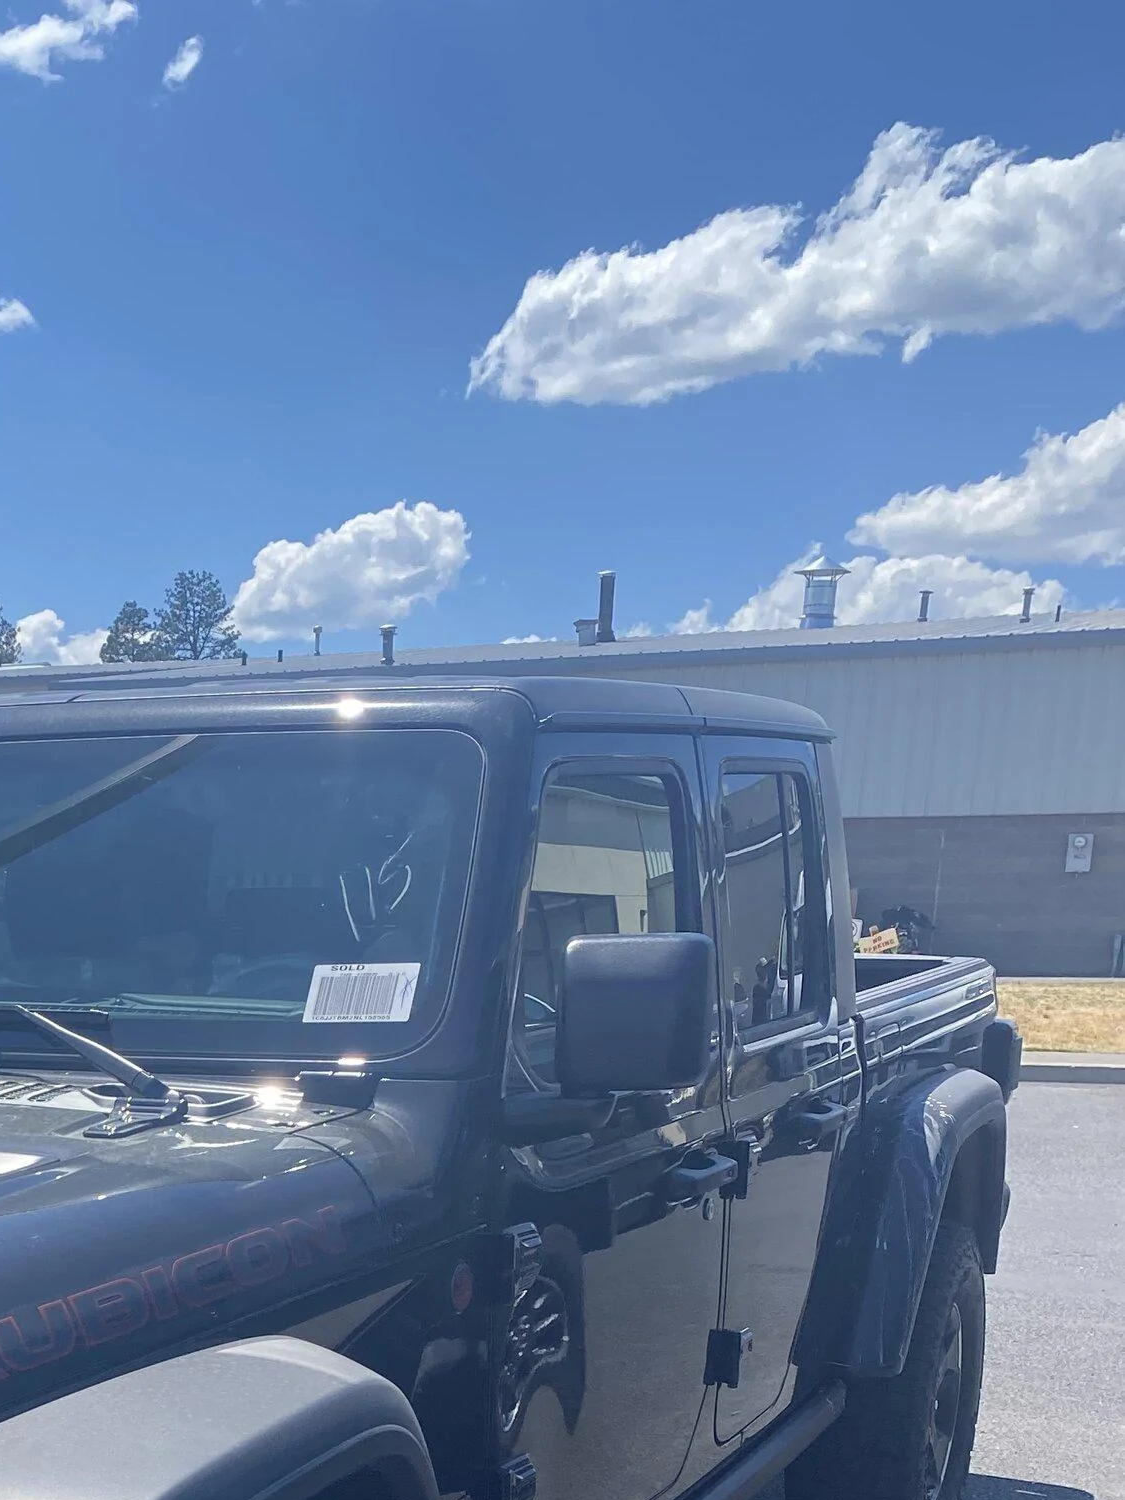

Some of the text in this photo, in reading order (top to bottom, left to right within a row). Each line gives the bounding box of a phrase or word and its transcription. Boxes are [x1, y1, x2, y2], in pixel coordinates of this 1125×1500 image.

[872, 936, 883, 944] NO
[863, 938, 895, 954] PARKING
[330, 964, 366, 972] SOLD
